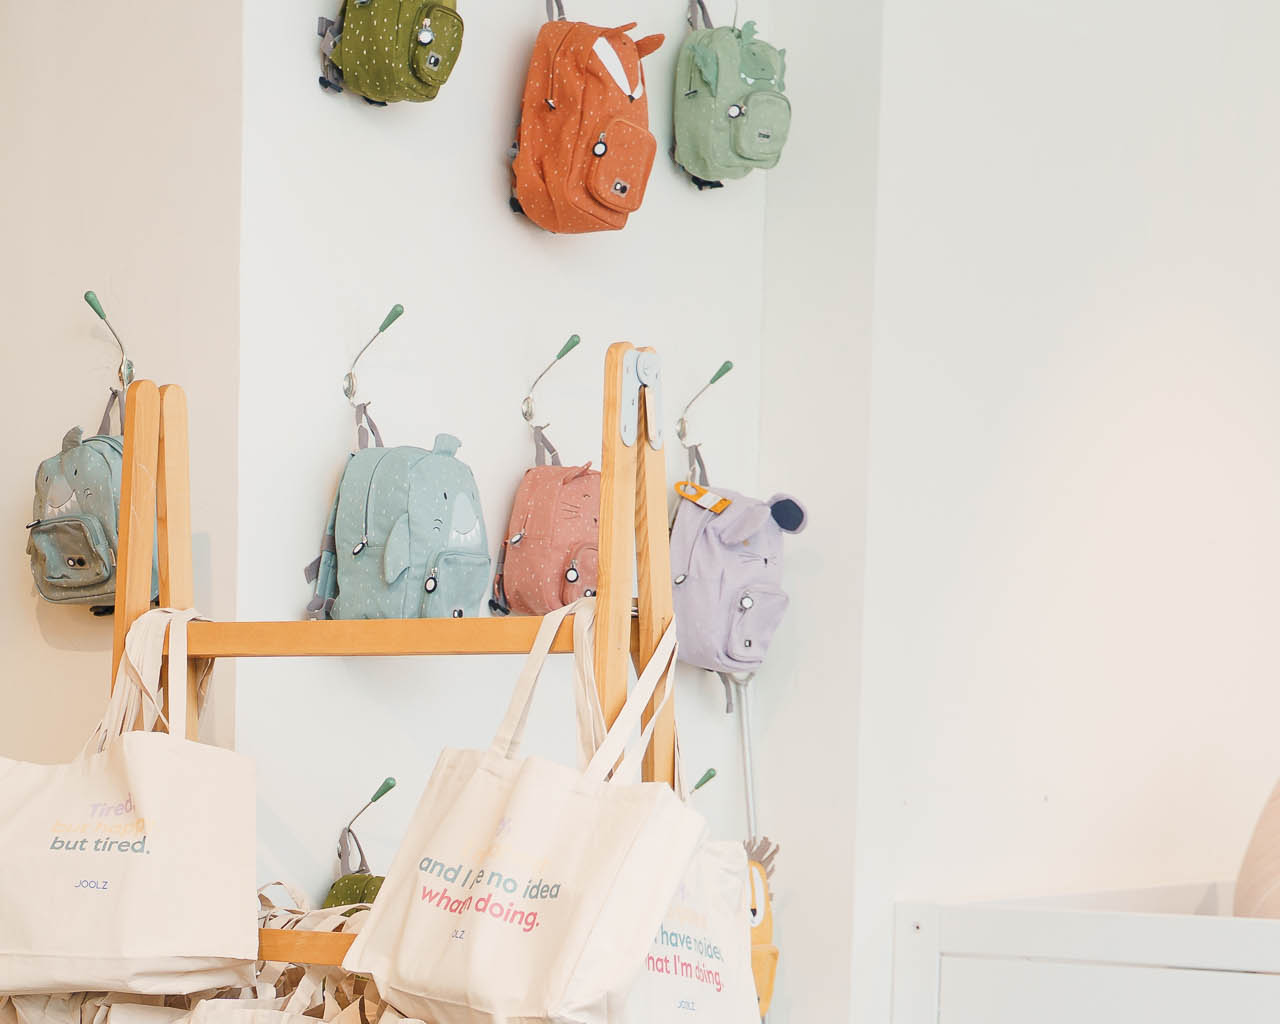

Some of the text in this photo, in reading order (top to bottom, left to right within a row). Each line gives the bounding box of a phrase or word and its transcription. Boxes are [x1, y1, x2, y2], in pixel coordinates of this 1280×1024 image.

[49, 835, 150, 855] but tired.
[73, 879, 109, 890] JOOLZ
[419, 857, 463, 883] and
[487, 871, 518, 894] no
[523, 879, 561, 899] idea
[474, 893, 540, 933] doing.
[661, 921, 693, 951] have
[647, 952, 671, 975] hat
[673, 954, 693, 979] I'm
